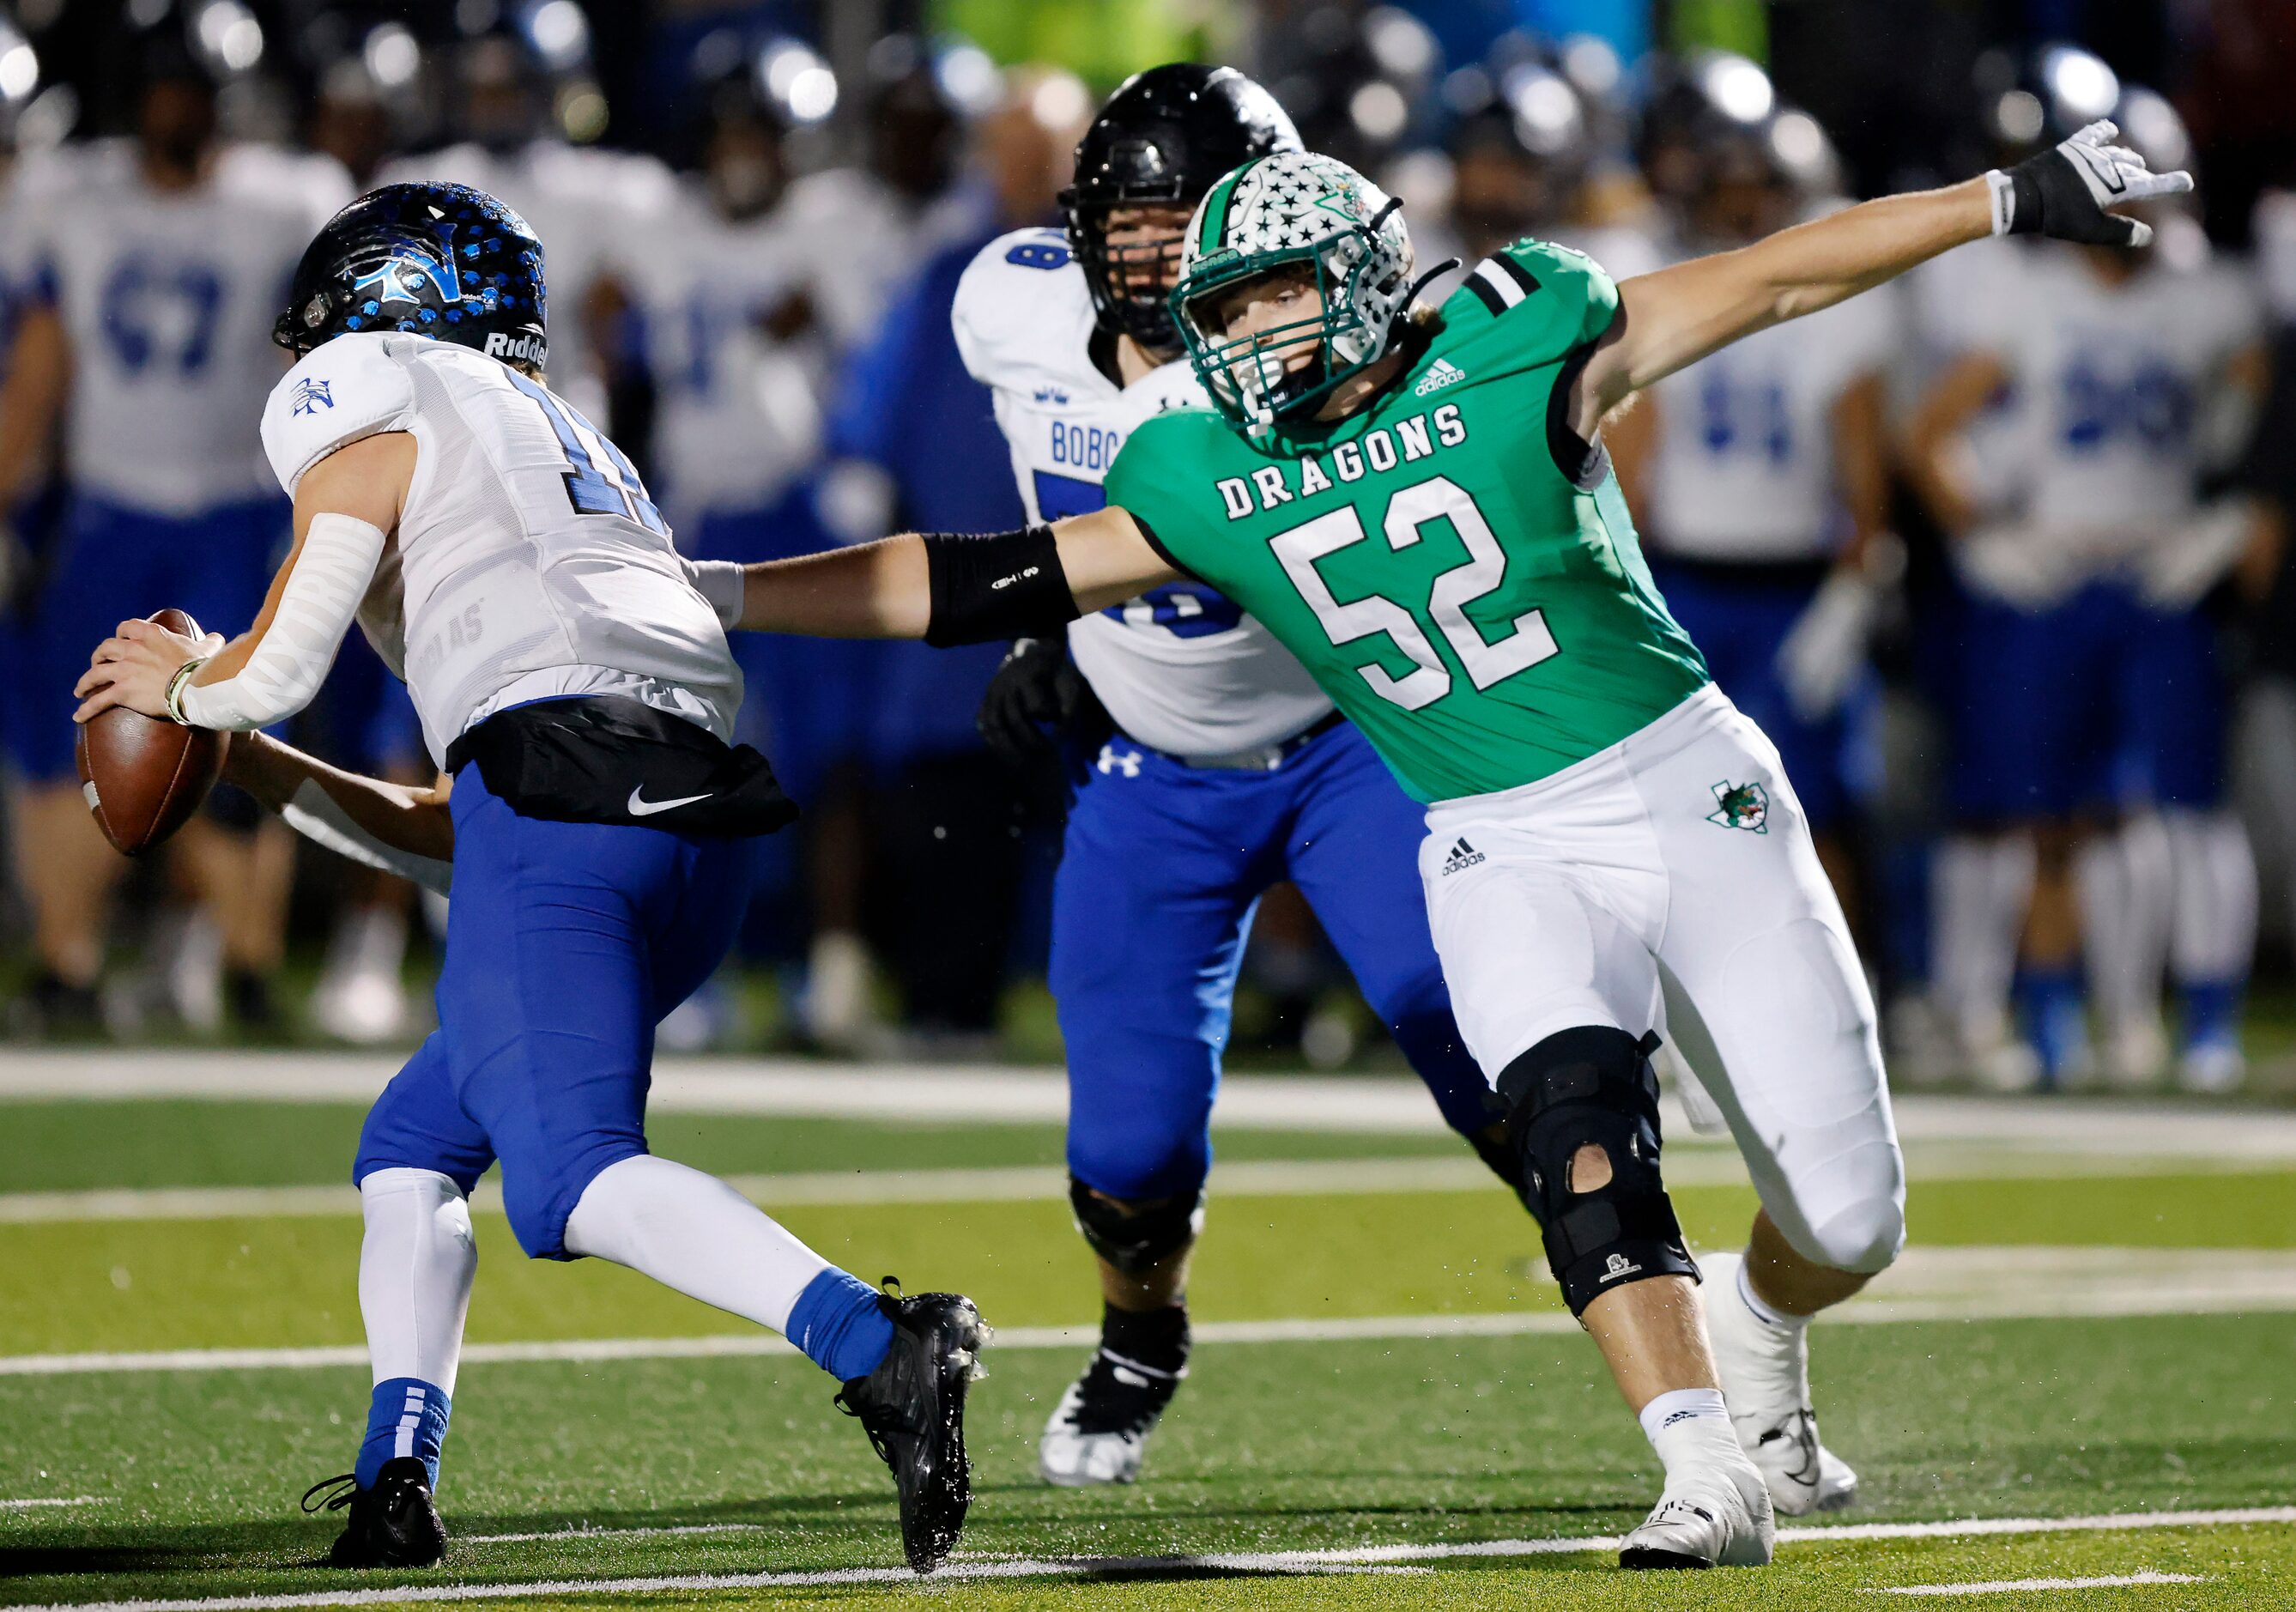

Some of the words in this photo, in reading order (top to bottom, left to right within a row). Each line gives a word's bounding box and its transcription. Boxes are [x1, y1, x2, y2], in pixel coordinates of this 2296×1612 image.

[1415, 369, 1466, 397] adidas
[1215, 403, 1468, 522] DRAGONS
[1264, 473, 1562, 712] 52
[1442, 852, 1486, 876] adidas
